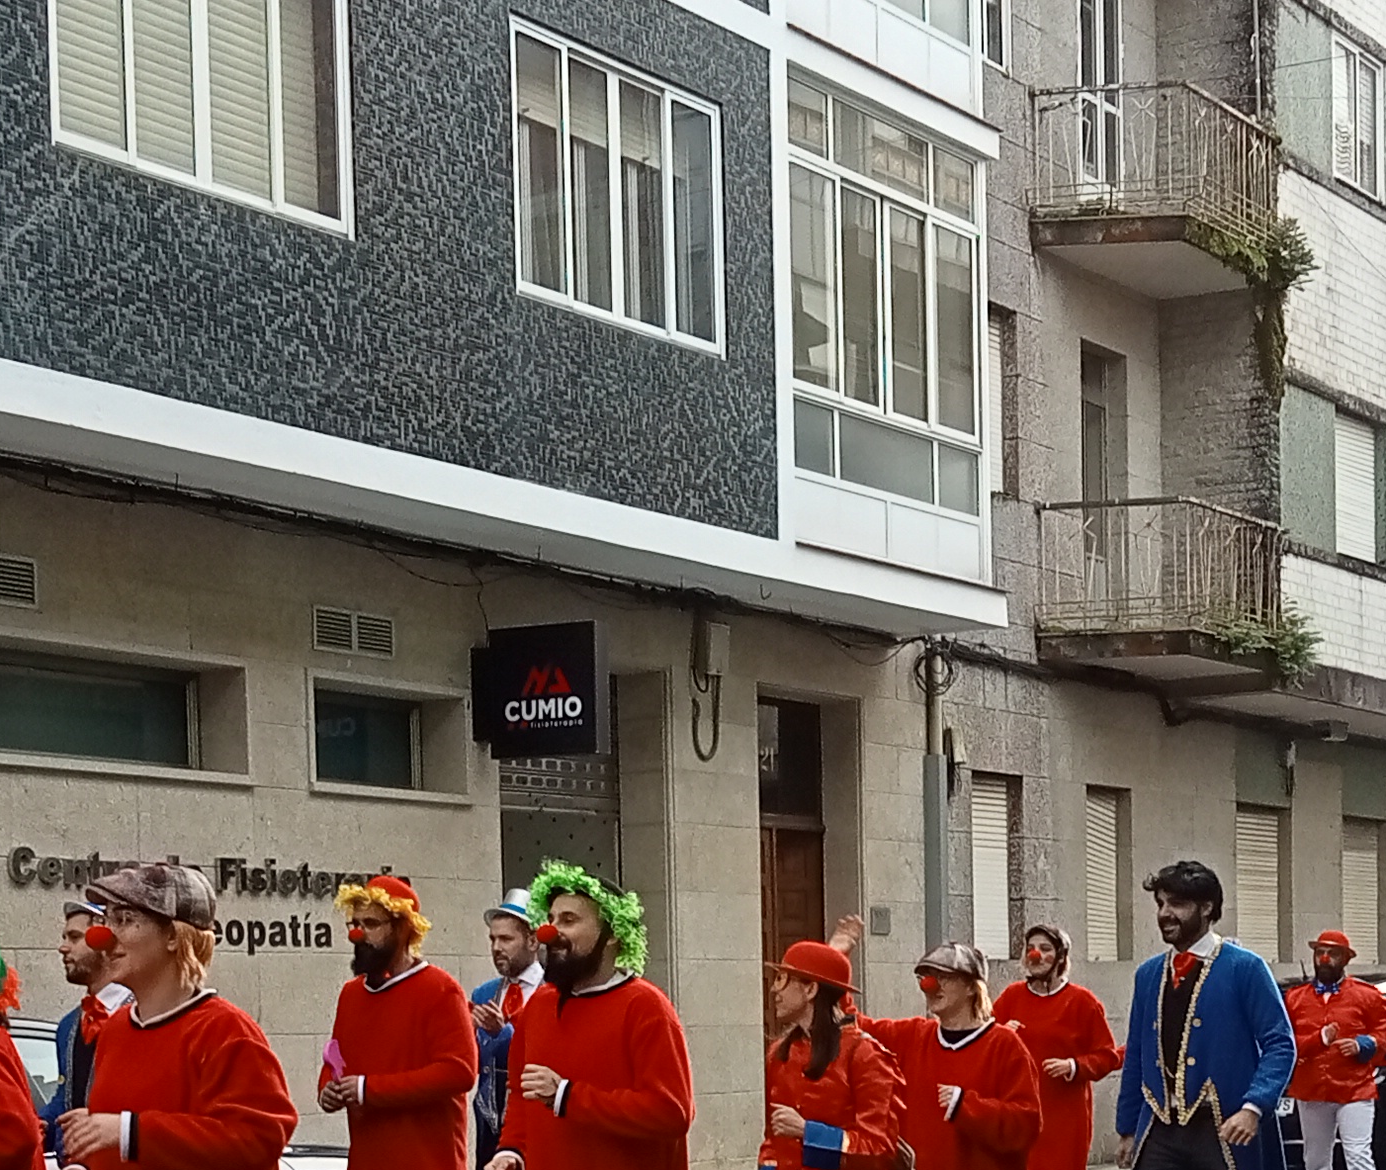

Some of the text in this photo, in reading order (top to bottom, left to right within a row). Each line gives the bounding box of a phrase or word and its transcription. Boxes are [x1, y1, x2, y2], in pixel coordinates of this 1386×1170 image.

[505, 695, 582, 722] CUMIO
[530, 718, 583, 729] fisioterapia
[8, 847, 140, 891] Centr
[213, 912, 332, 956] eopatía
